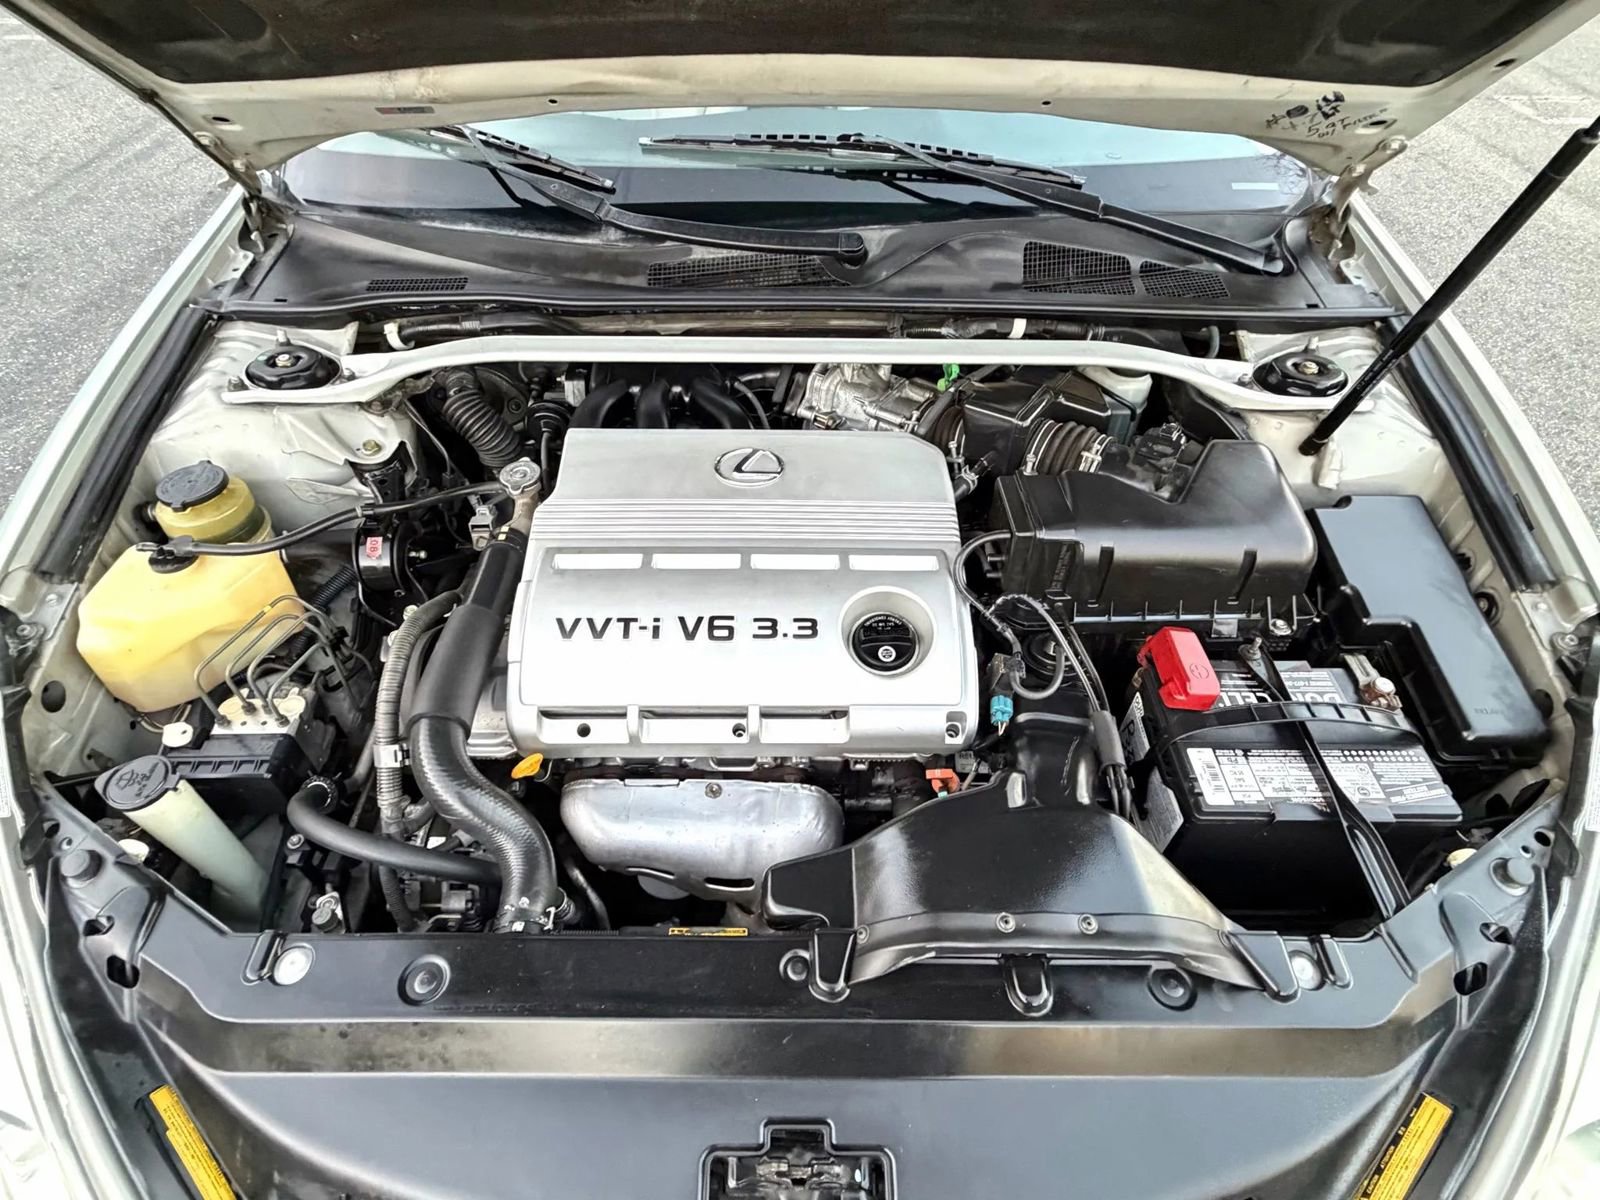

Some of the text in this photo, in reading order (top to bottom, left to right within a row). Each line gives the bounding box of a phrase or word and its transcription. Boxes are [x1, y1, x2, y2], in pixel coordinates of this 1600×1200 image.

[555, 615, 818, 641] VVT-i V6 3.3
